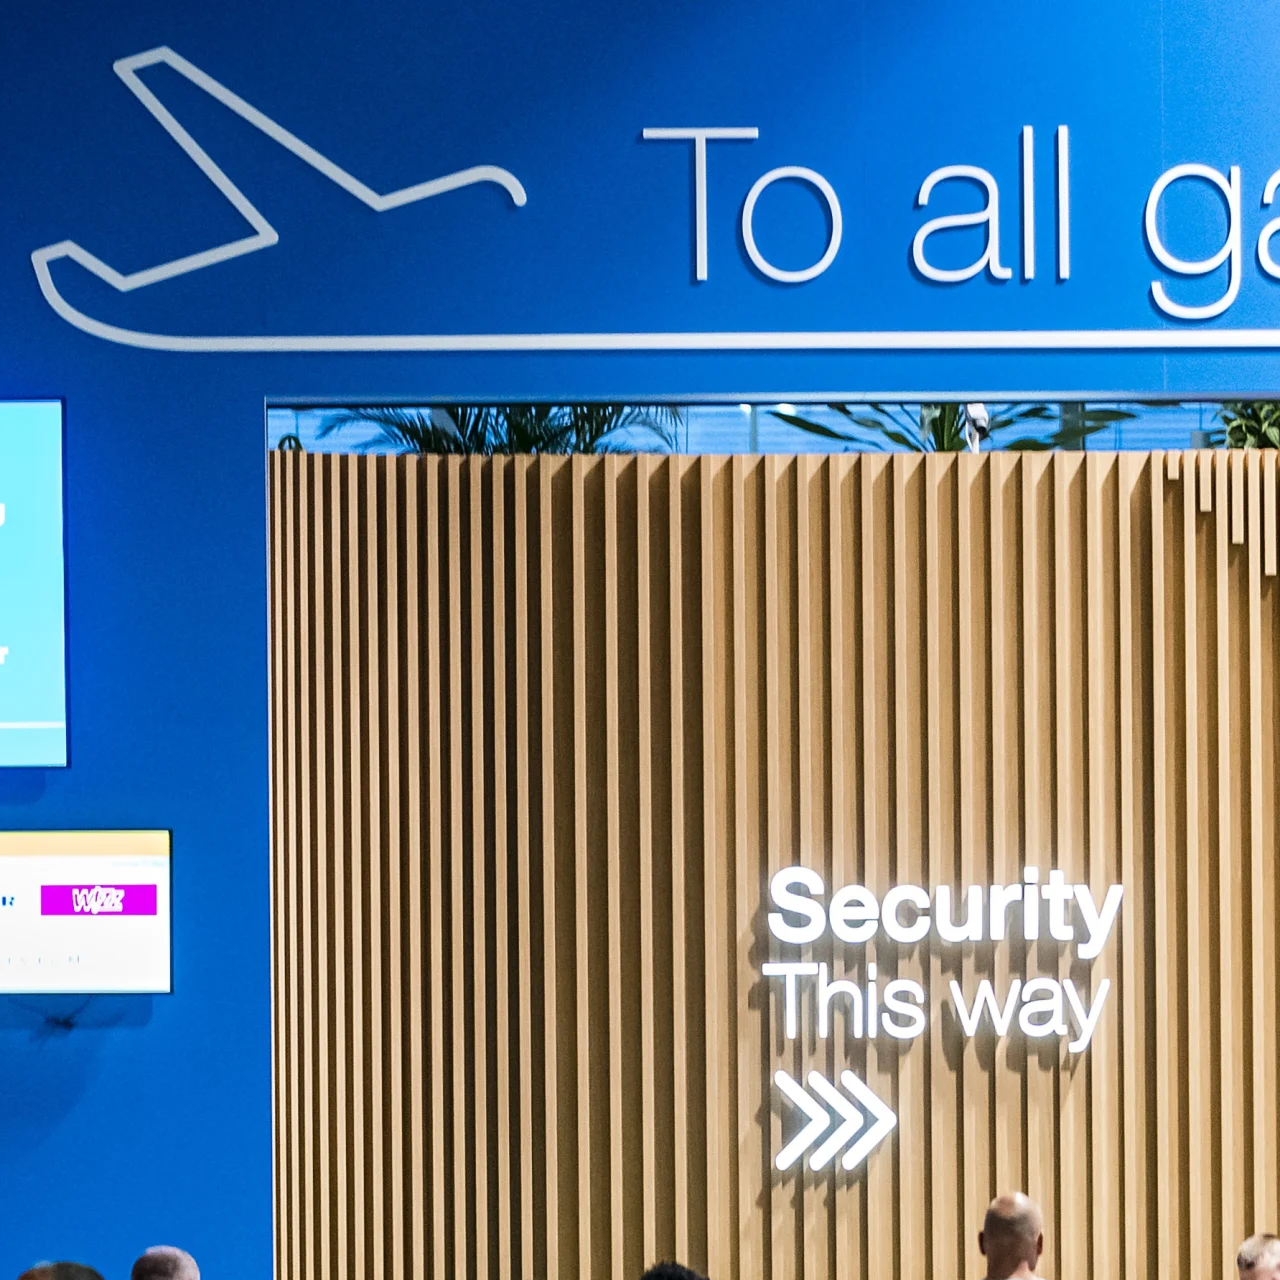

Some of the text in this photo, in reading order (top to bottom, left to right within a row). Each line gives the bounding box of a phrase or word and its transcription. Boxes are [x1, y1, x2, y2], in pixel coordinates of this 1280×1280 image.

[642, 126, 843, 284] To
[911, 125, 1071, 284] all
[767, 866, 1125, 960] Security
[762, 962, 1111, 1054] This way
